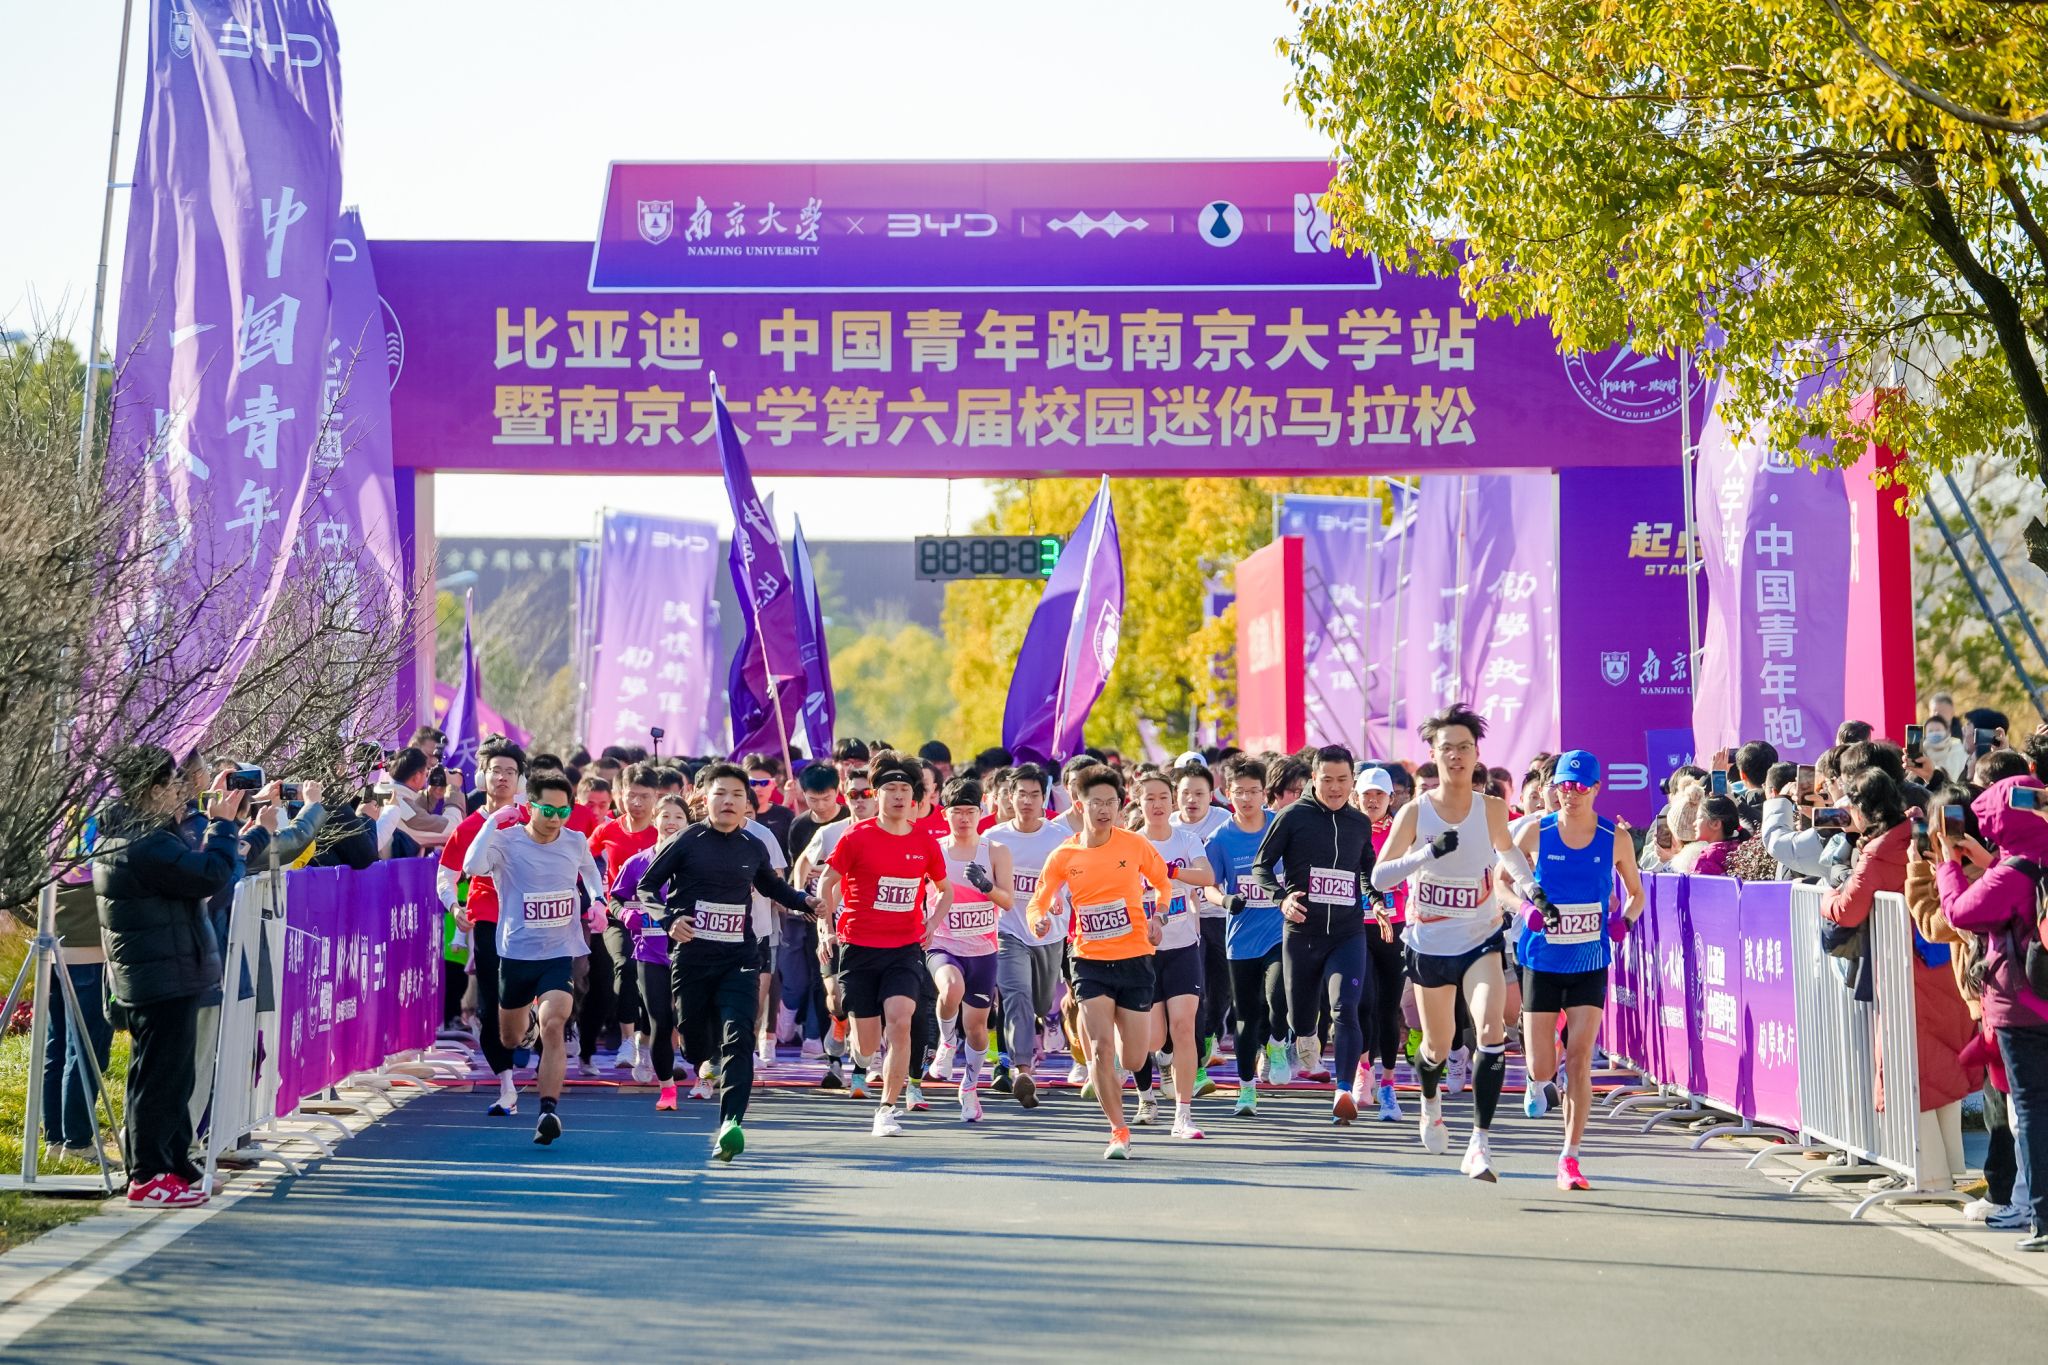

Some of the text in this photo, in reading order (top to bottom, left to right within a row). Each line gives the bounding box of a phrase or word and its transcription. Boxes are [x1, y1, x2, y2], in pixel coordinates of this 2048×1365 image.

[217, 22, 323, 68] BYD
[887, 213, 998, 237] BYD
[687, 246, 820, 256] NANJING UNIVERSITY
[493, 307, 1477, 374] 比亚迪·中国青年跑南京大学站
[226, 186, 307, 567] 中国青年
[491, 384, 1477, 447] 暨南京大学第六届校园迷你马拉松
[1592, 396, 1617, 414] CHINA
[1621, 410, 1651, 419] YOUTH
[1654, 382, 1696, 416] MARATN
[652, 531, 711, 553] BYD
[1640, 686, 1684, 695] NANJING
